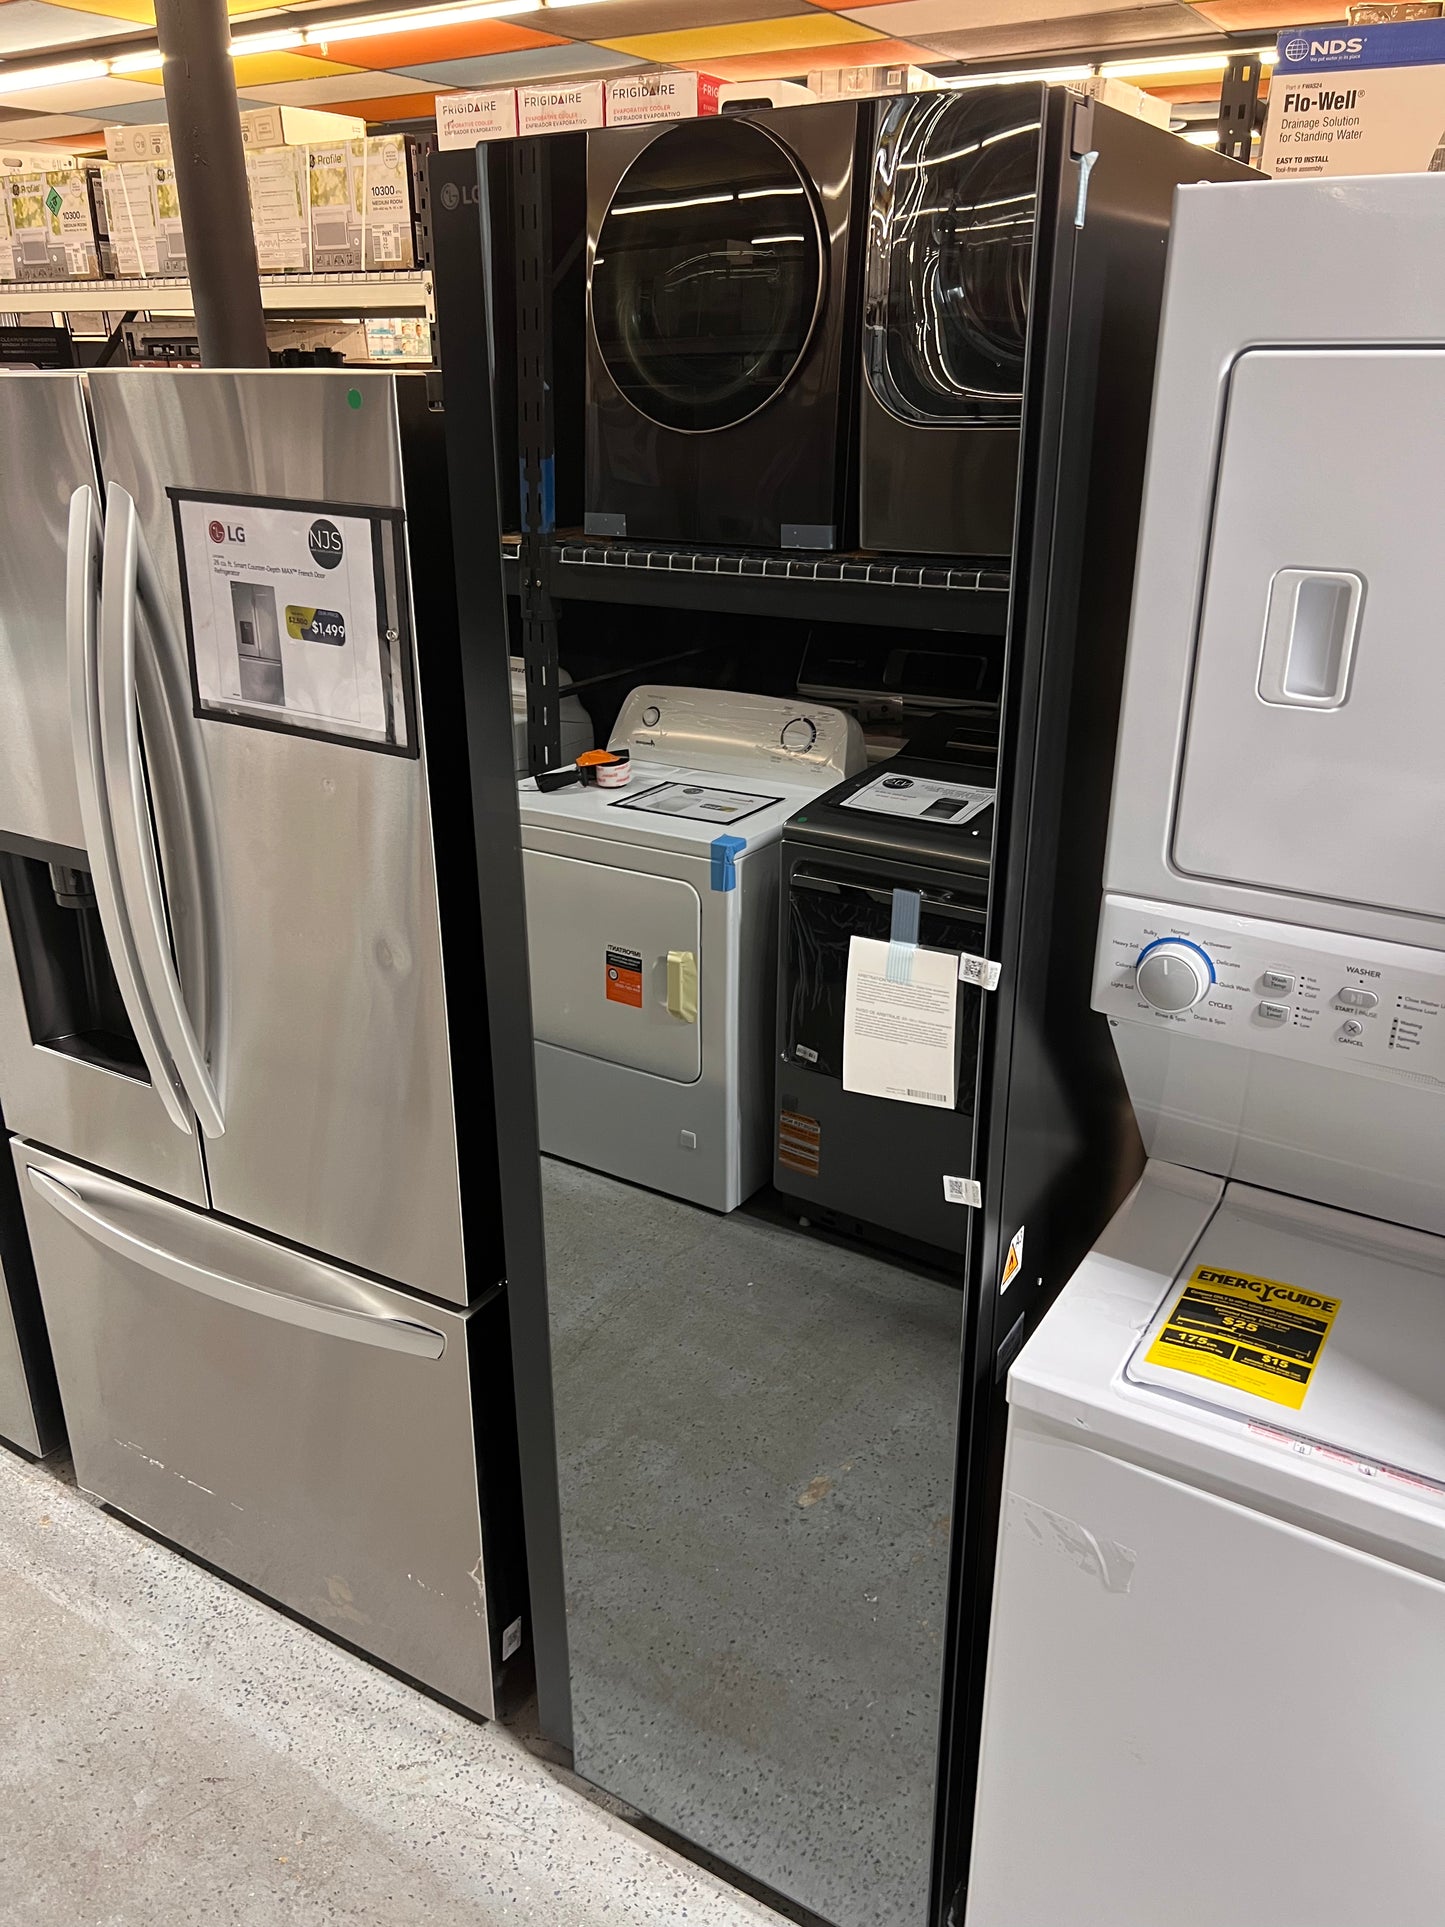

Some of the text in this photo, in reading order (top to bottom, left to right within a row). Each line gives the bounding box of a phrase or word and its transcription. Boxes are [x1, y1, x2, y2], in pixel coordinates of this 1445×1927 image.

[1310, 38, 1363, 56] NDS
[612, 84, 675, 99] FRIGIDAIRE
[524, 93, 582, 108] FRIGIDAIRE
[442, 101, 497, 116] FRIGIDAIRE
[613, 104, 671, 114] EVAPORATIVE COOLER
[525, 112, 578, 122] EVAPORATIVE COOLER
[613, 111, 681, 121] ENFRIADOR EVAPORATIVO
[525, 119, 588, 130] ENFRIADOR EVAPORATIVO
[1281, 116, 1360, 130] Drainage Solution
[470, 126, 503, 134] EVAPORATIVO
[1279, 129, 1363, 143] for Standing Water
[317, 153, 342, 165] Profile
[1276, 155, 1329, 165] EASY TO INSTALL
[371, 185, 395, 197] 10300
[62, 211, 81, 220] 10300
[227, 525, 246, 543] LG
[309, 530, 342, 551] NJS
[312, 620, 345, 638] $1,499
[1143, 929, 1158, 937] Bulky
[1171, 928, 1190, 936] Normal
[1113, 940, 1129, 948] Heavy
[1202, 940, 1232, 950] Activewear
[1216, 959, 1241, 969] Delicates
[1346, 966, 1381, 978] WASHER
[1110, 981, 1124, 990] Light
[1271, 976, 1287, 984] Wash
[1271, 981, 1286, 989] Temp
[1219, 981, 1251, 992] Quick Wash
[1208, 1000, 1233, 1011] CYCLES
[1155, 1011, 1169, 1019] Rinse
[1334, 1005, 1378, 1019] START PAUSE
[1338, 1037, 1364, 1047] CANCEL
[1198, 1270, 1336, 1312] ENERGYGUIDE
[1212, 1293, 1228, 1301] ONLY
[1222, 1316, 1258, 1332] $25
[1178, 1333, 1207, 1345] 175
[1261, 1354, 1289, 1369] $15
